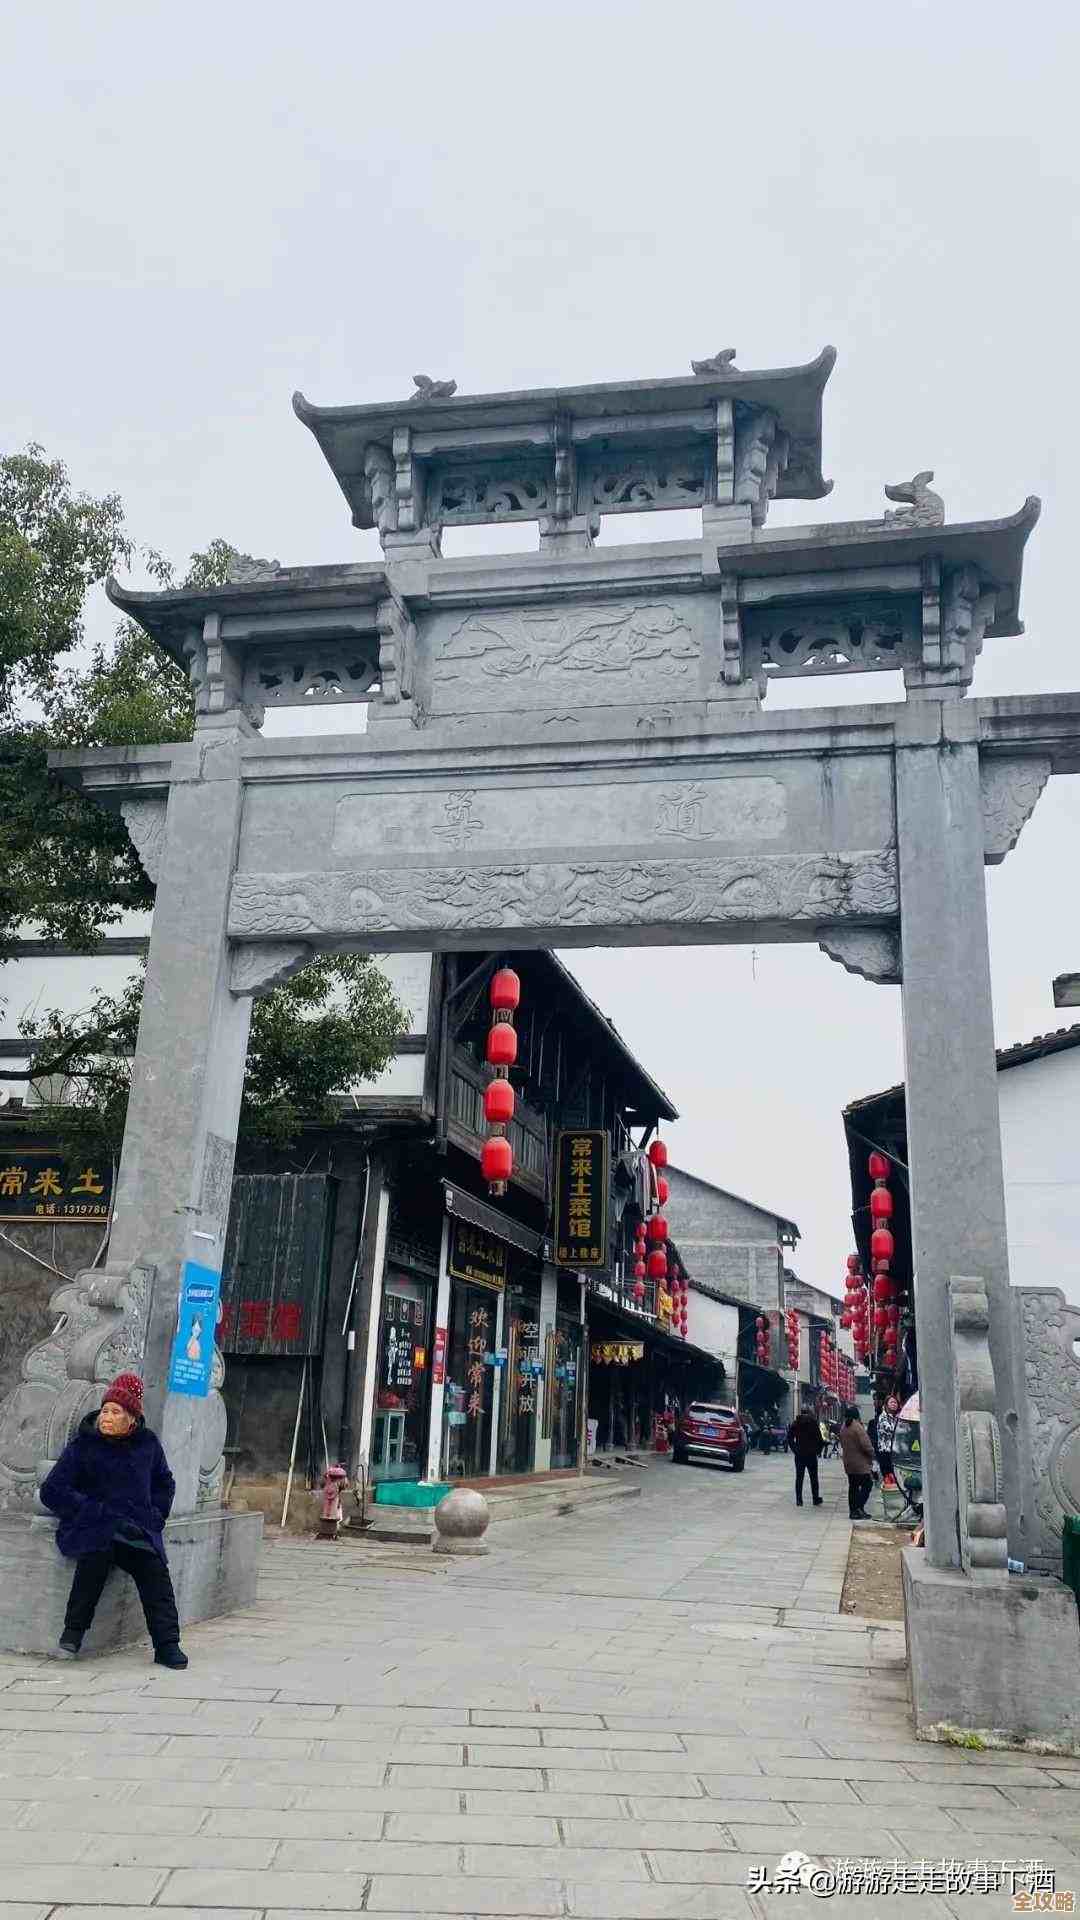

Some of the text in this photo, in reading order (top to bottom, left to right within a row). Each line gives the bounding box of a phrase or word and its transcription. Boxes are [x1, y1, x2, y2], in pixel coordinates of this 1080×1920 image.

[0, 1166, 104, 1195] 常来土
[569, 1138, 592, 1238] 常来土菜馆
